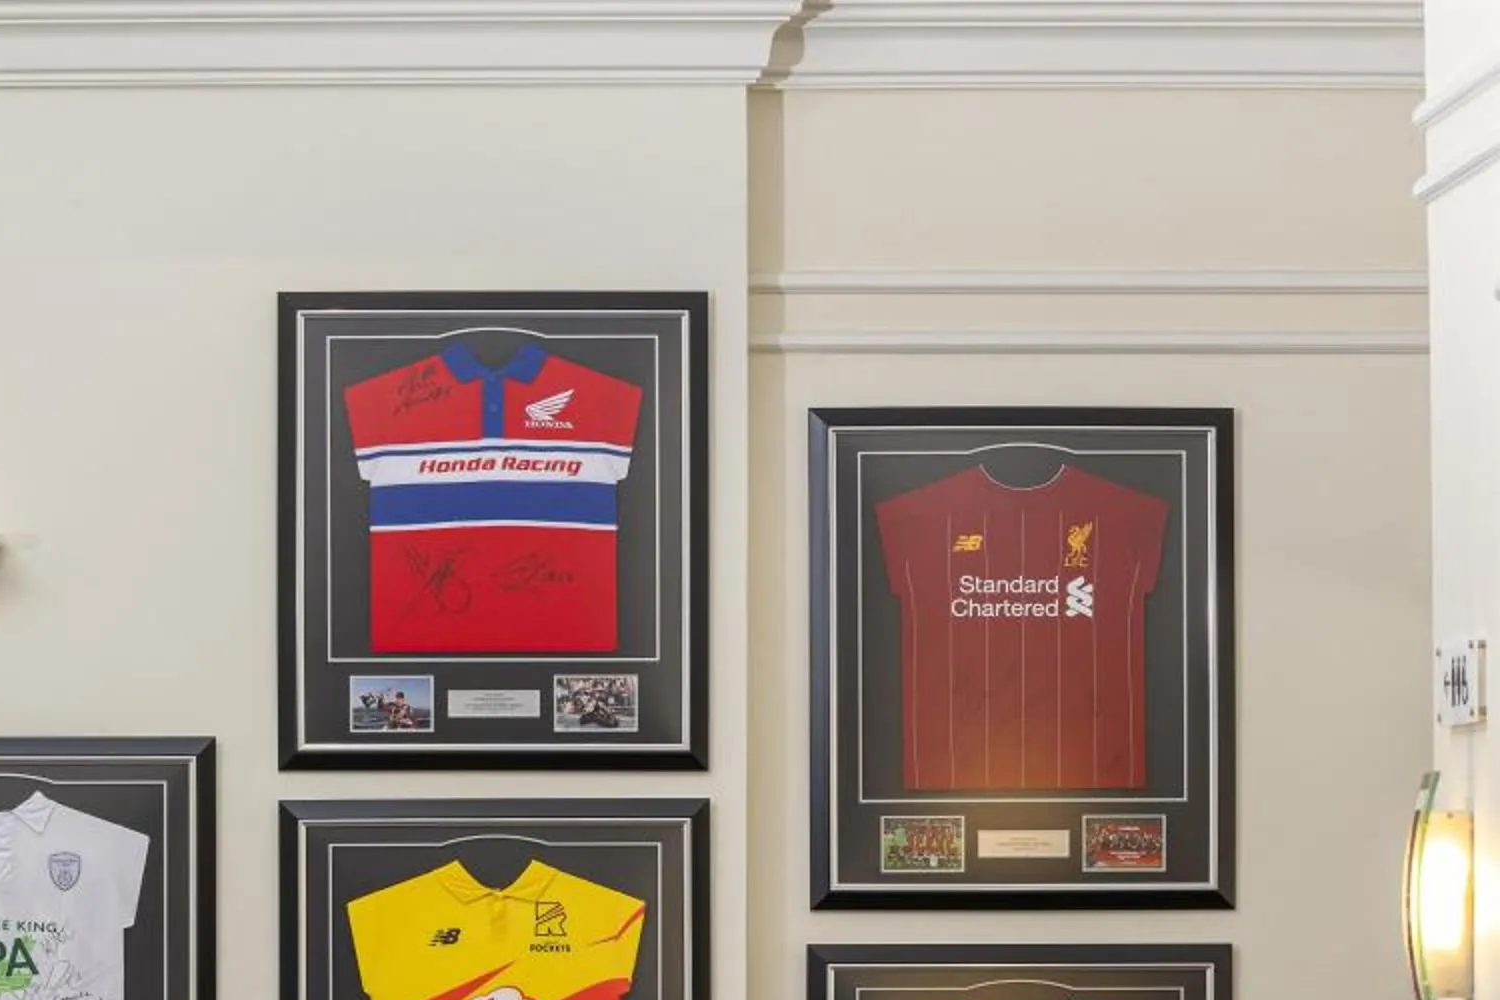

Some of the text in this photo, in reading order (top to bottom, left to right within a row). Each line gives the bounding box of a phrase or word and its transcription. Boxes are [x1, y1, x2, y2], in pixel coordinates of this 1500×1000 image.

[524, 420, 574, 429] HONDA
[419, 456, 582, 476] Honda Racing
[959, 575, 1059, 593] Standard
[951, 598, 1059, 617] Chartered
[17, 920, 58, 933] KING
